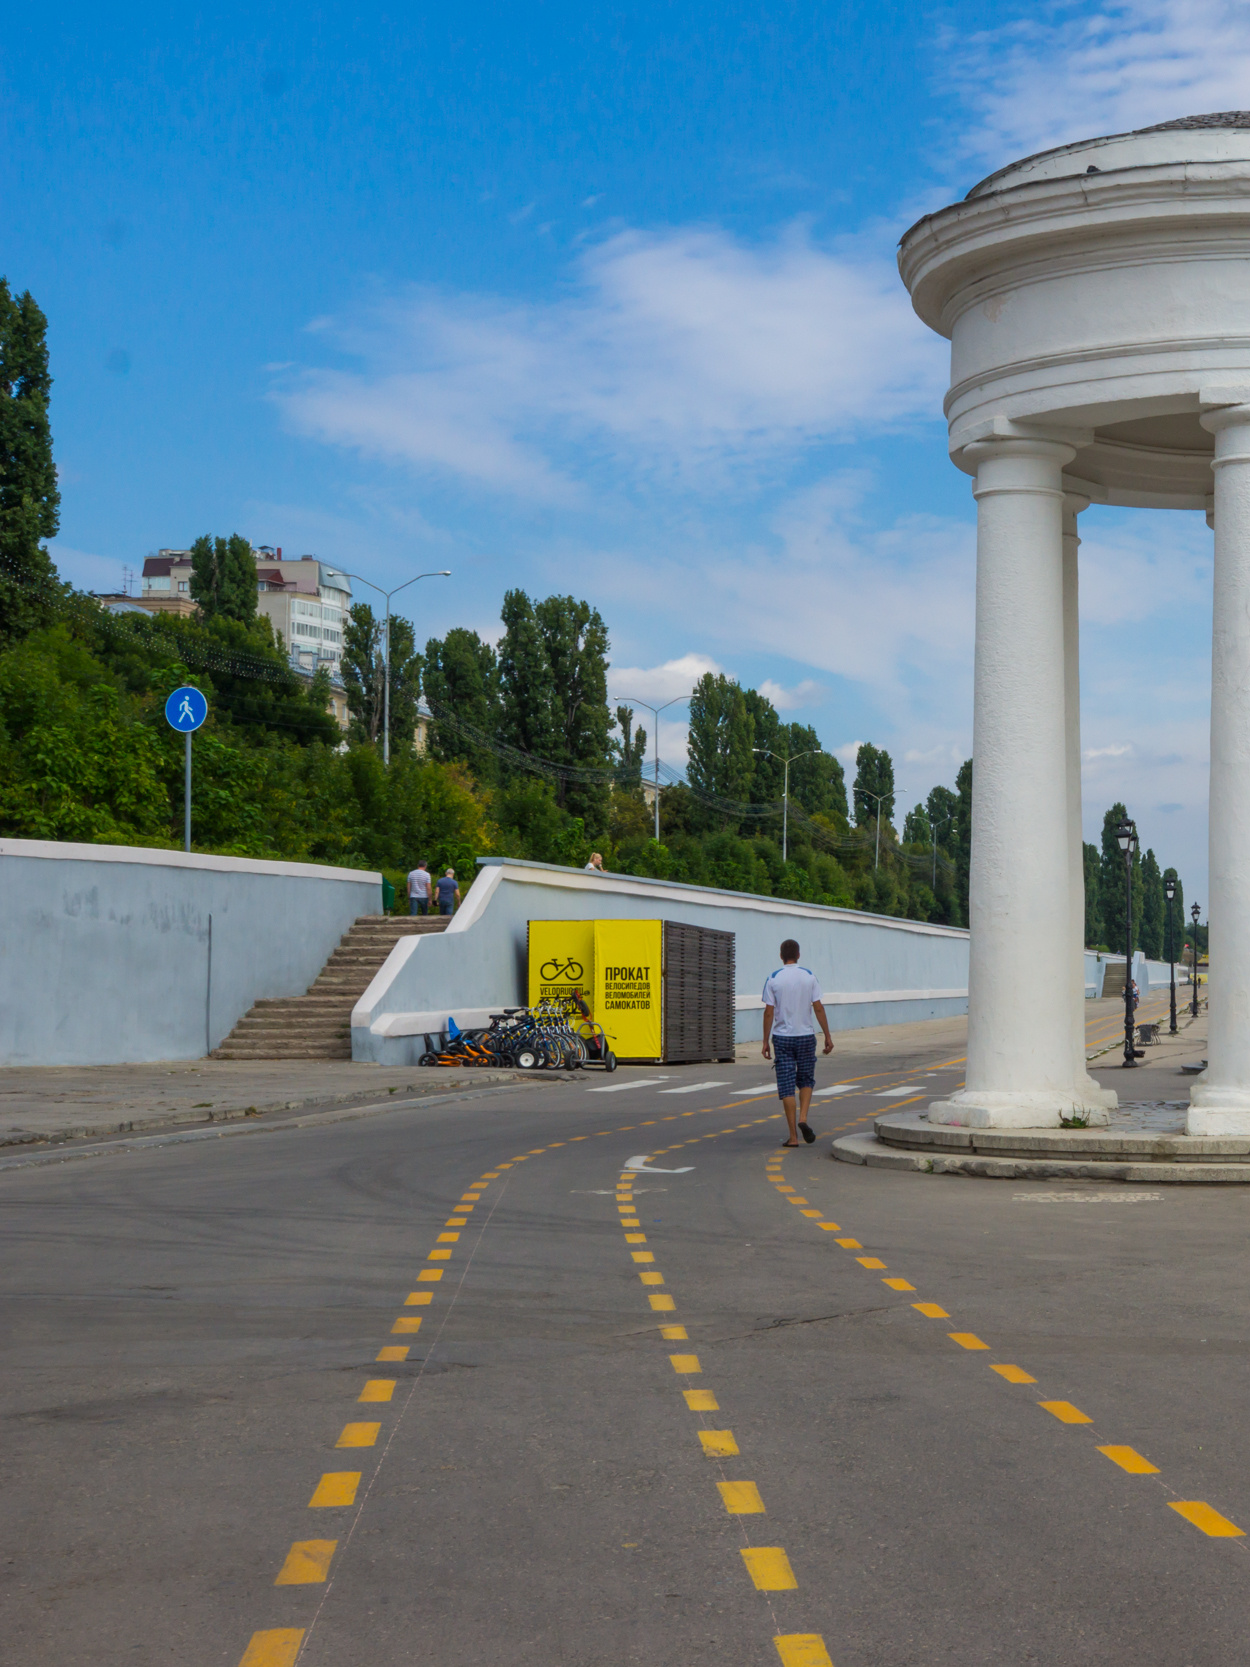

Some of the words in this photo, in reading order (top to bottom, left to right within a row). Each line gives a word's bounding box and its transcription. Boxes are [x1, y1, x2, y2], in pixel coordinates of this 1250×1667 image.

[605, 967, 650, 981] ПРОКАТ
[605, 982, 650, 991] ВЕЛОСИПЕДОВ
[605, 990, 650, 999] ВЕЛОМОБИЛЕЙ
[605, 1000, 650, 1010] САМОКАТОВ
